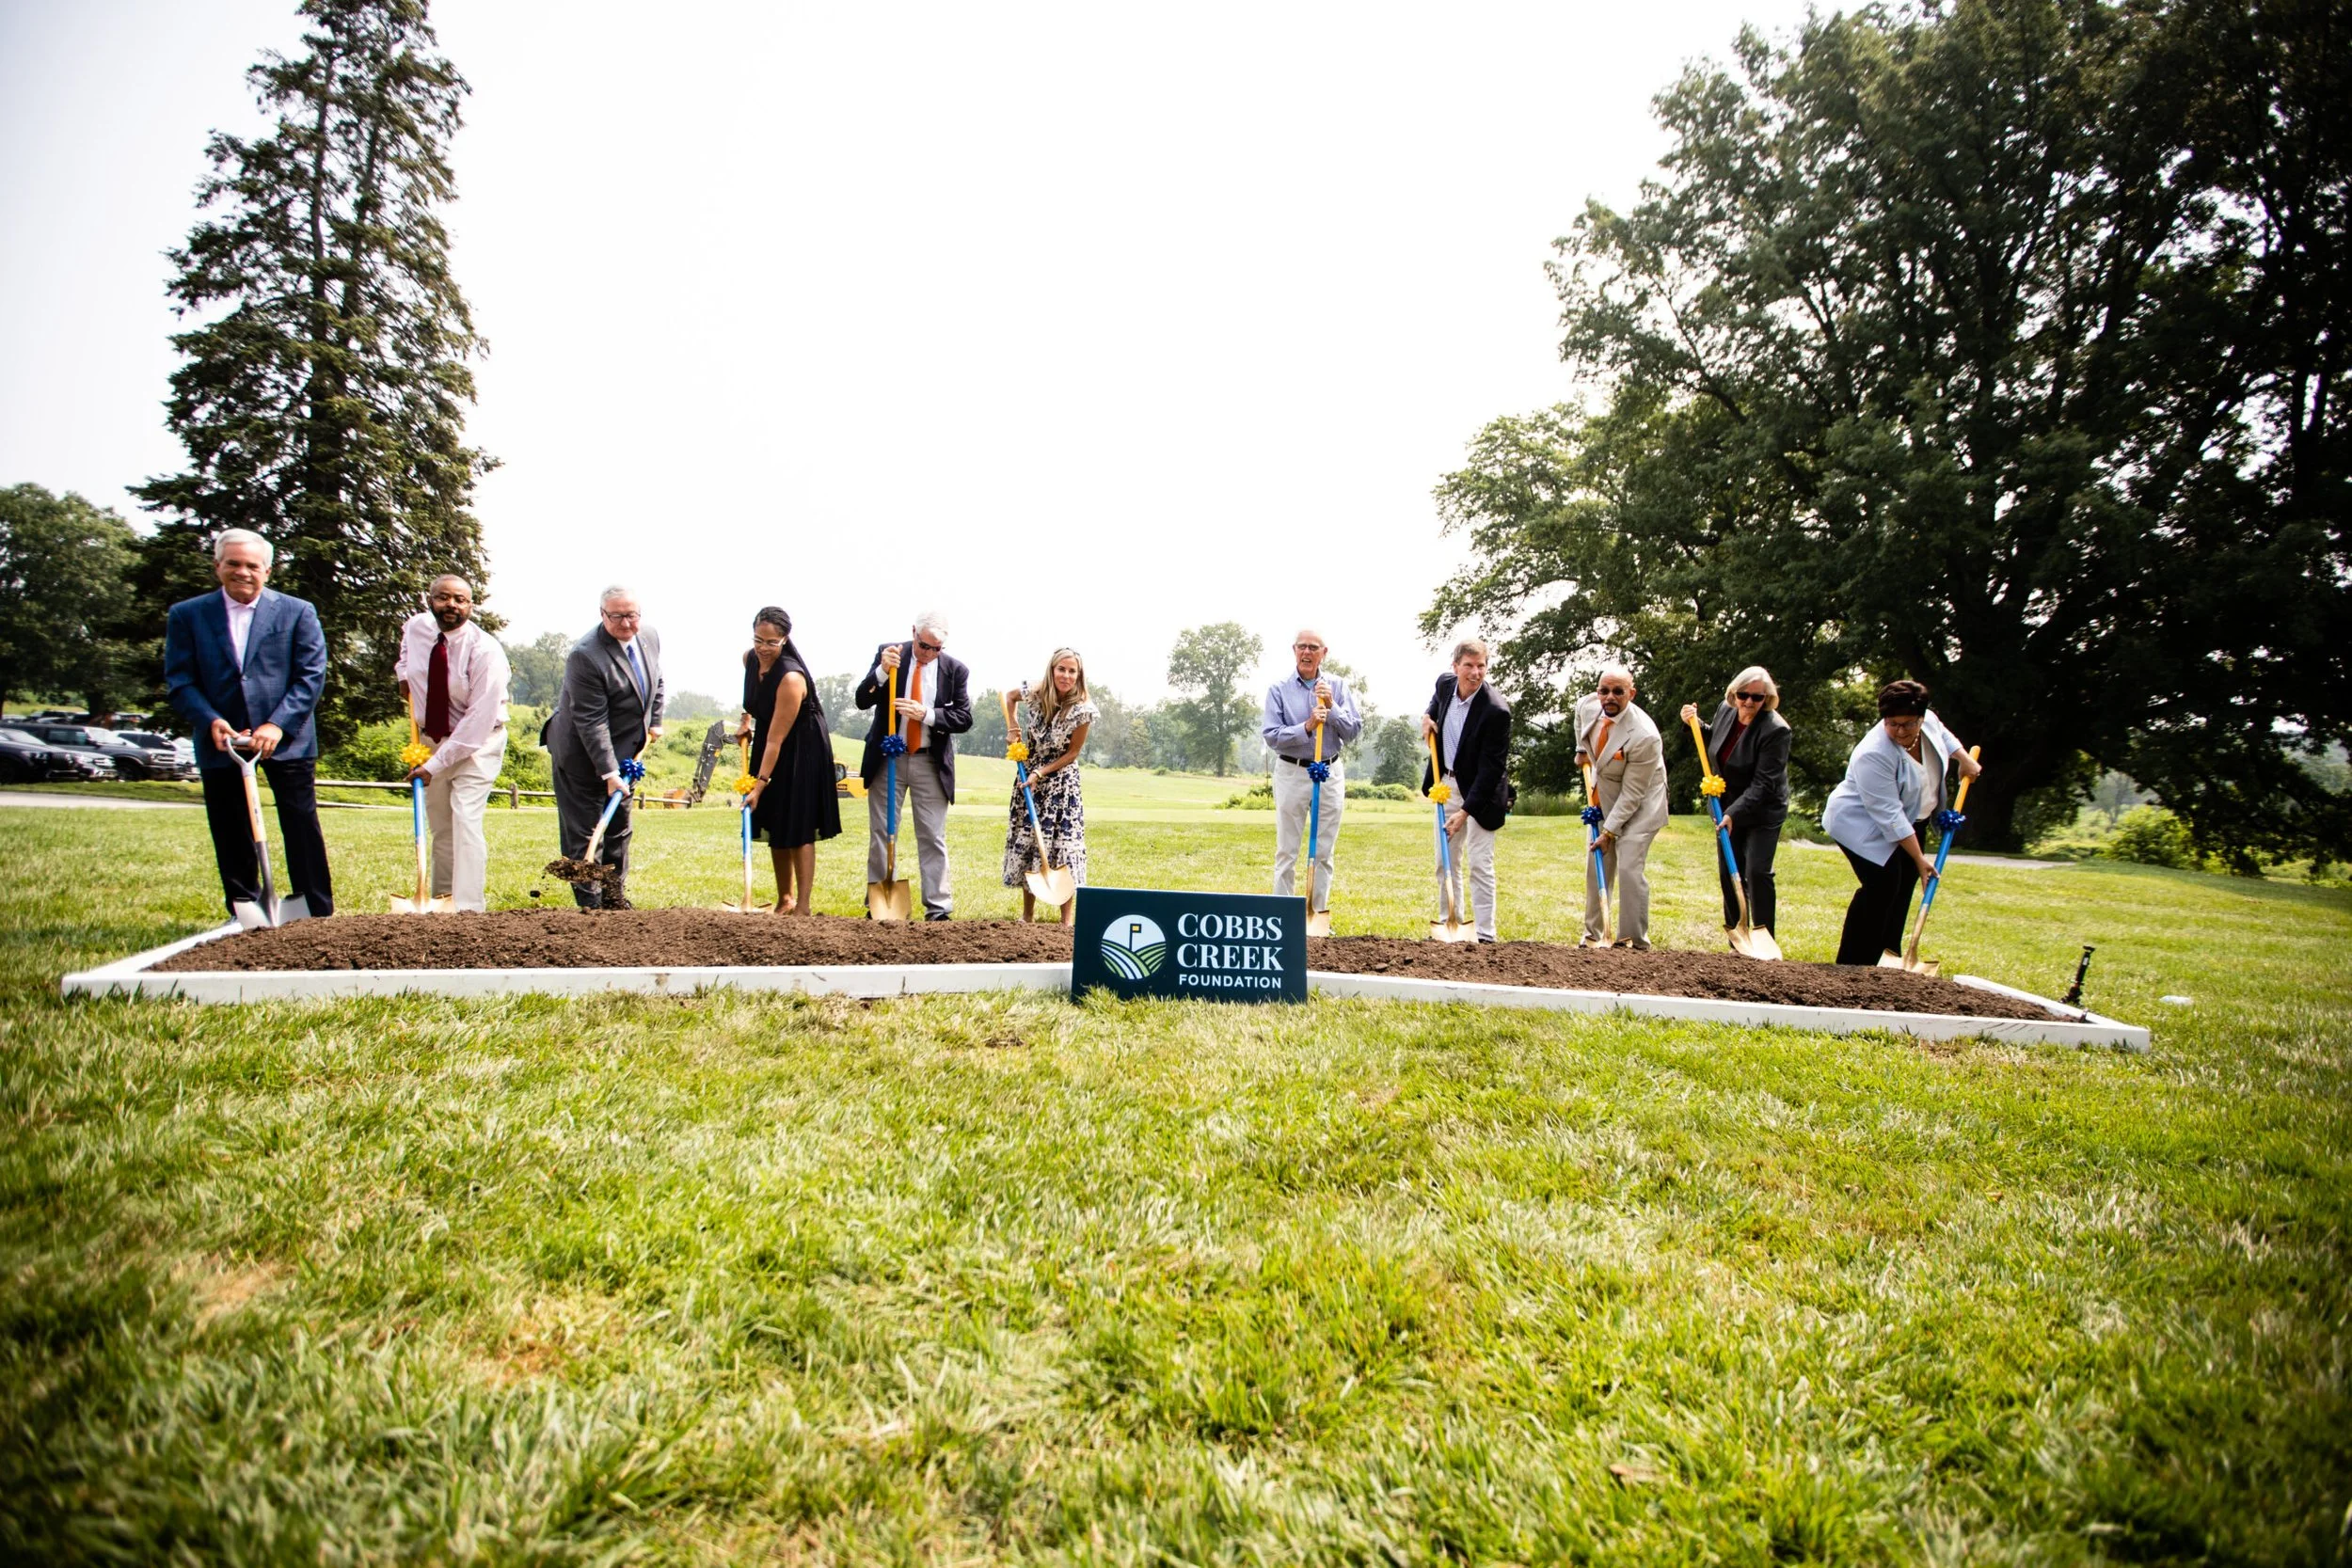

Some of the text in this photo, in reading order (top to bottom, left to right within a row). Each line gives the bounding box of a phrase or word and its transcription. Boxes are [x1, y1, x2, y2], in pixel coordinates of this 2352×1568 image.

[1177, 913, 1282, 942] COBBS
[1177, 943, 1284, 971] CREEK
[1179, 974, 1281, 989] FOUNDATION
